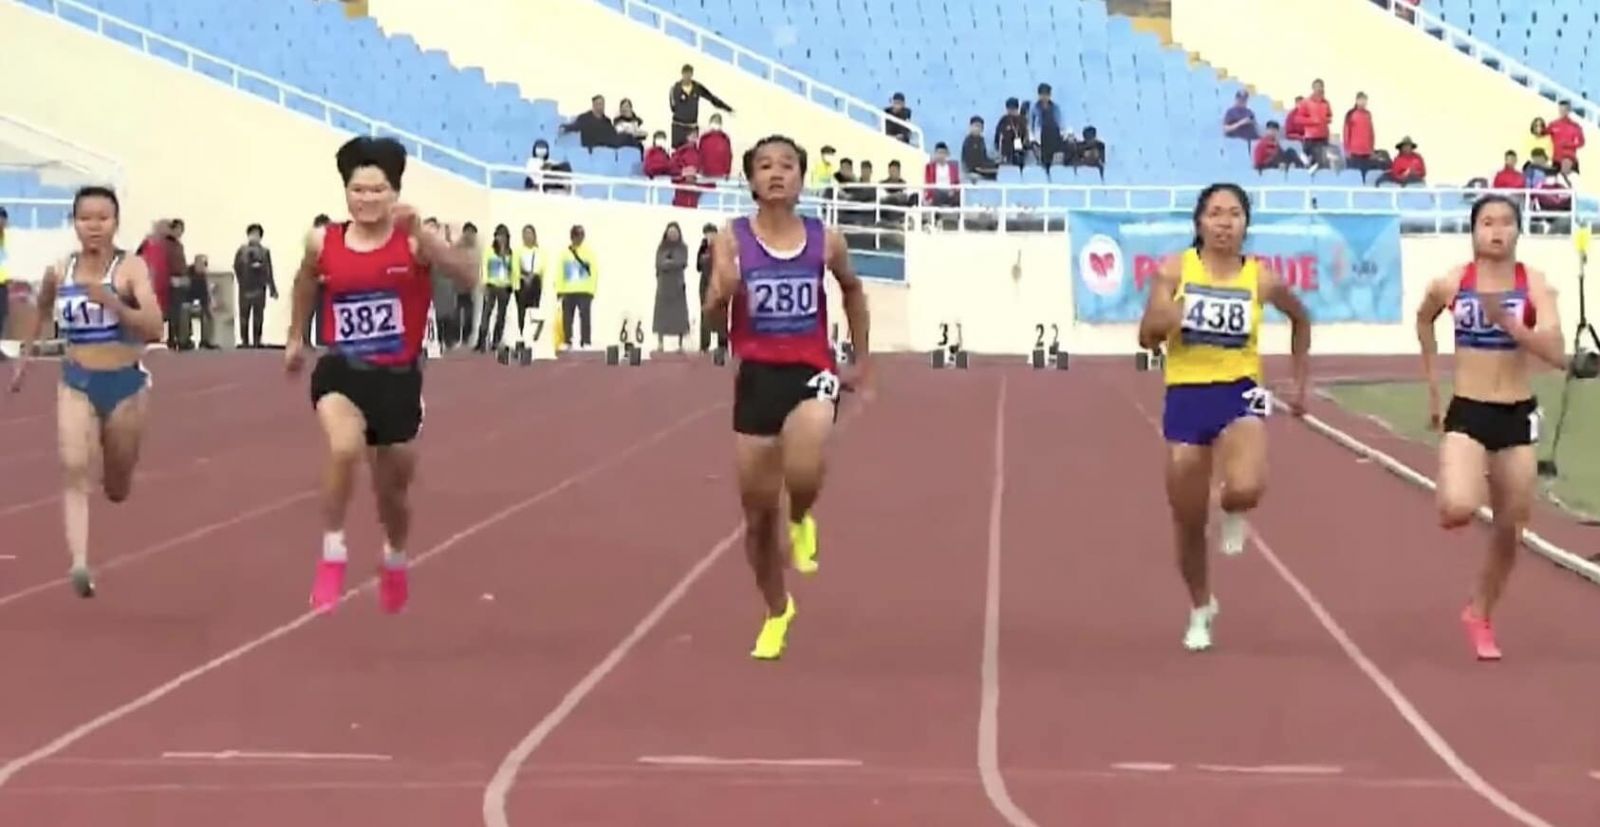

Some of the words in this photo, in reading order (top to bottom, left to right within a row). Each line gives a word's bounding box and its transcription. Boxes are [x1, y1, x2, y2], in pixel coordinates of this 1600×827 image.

[754, 282, 812, 313] 280
[340, 303, 396, 339] 382
[530, 318, 545, 342] 7
[1186, 300, 1246, 332] 438
